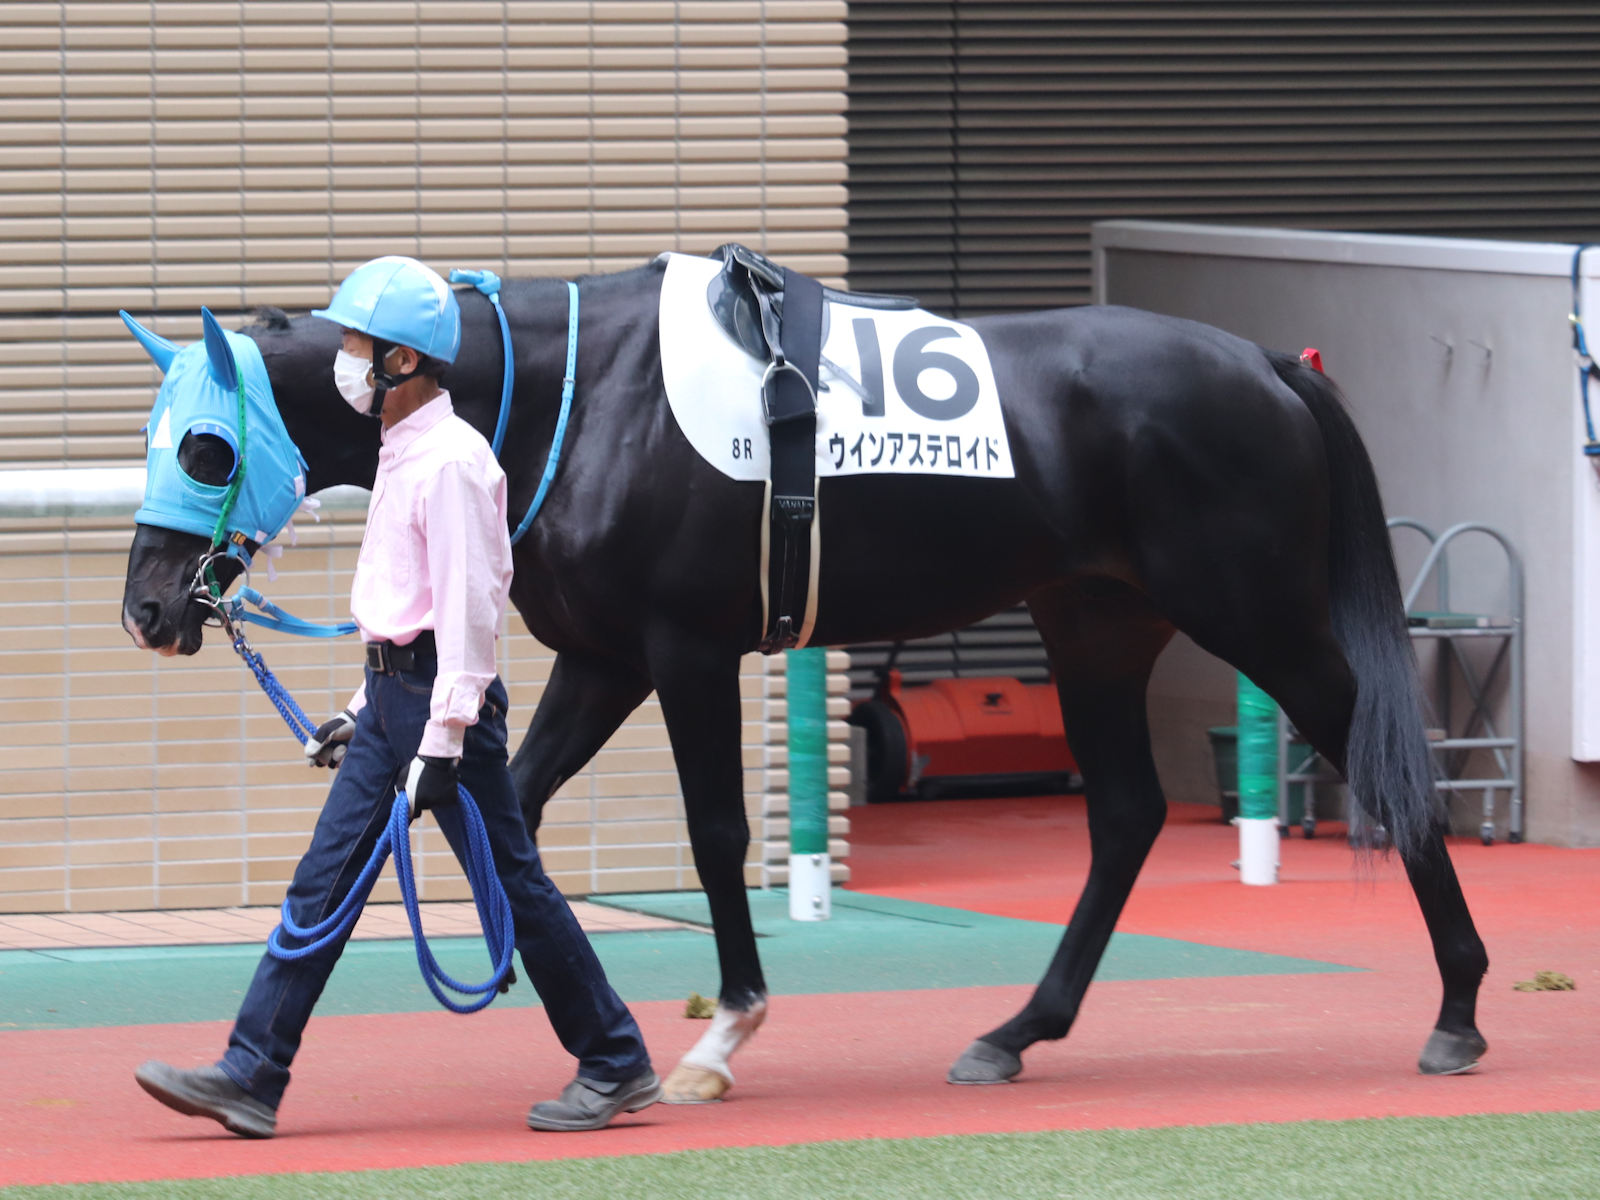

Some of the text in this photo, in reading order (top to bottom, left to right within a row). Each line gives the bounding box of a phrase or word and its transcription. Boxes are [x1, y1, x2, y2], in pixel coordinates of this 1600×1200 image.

[852, 318, 980, 421] 16
[732, 437, 753, 460] 8R
[829, 432, 999, 470] ウインアステロイド
